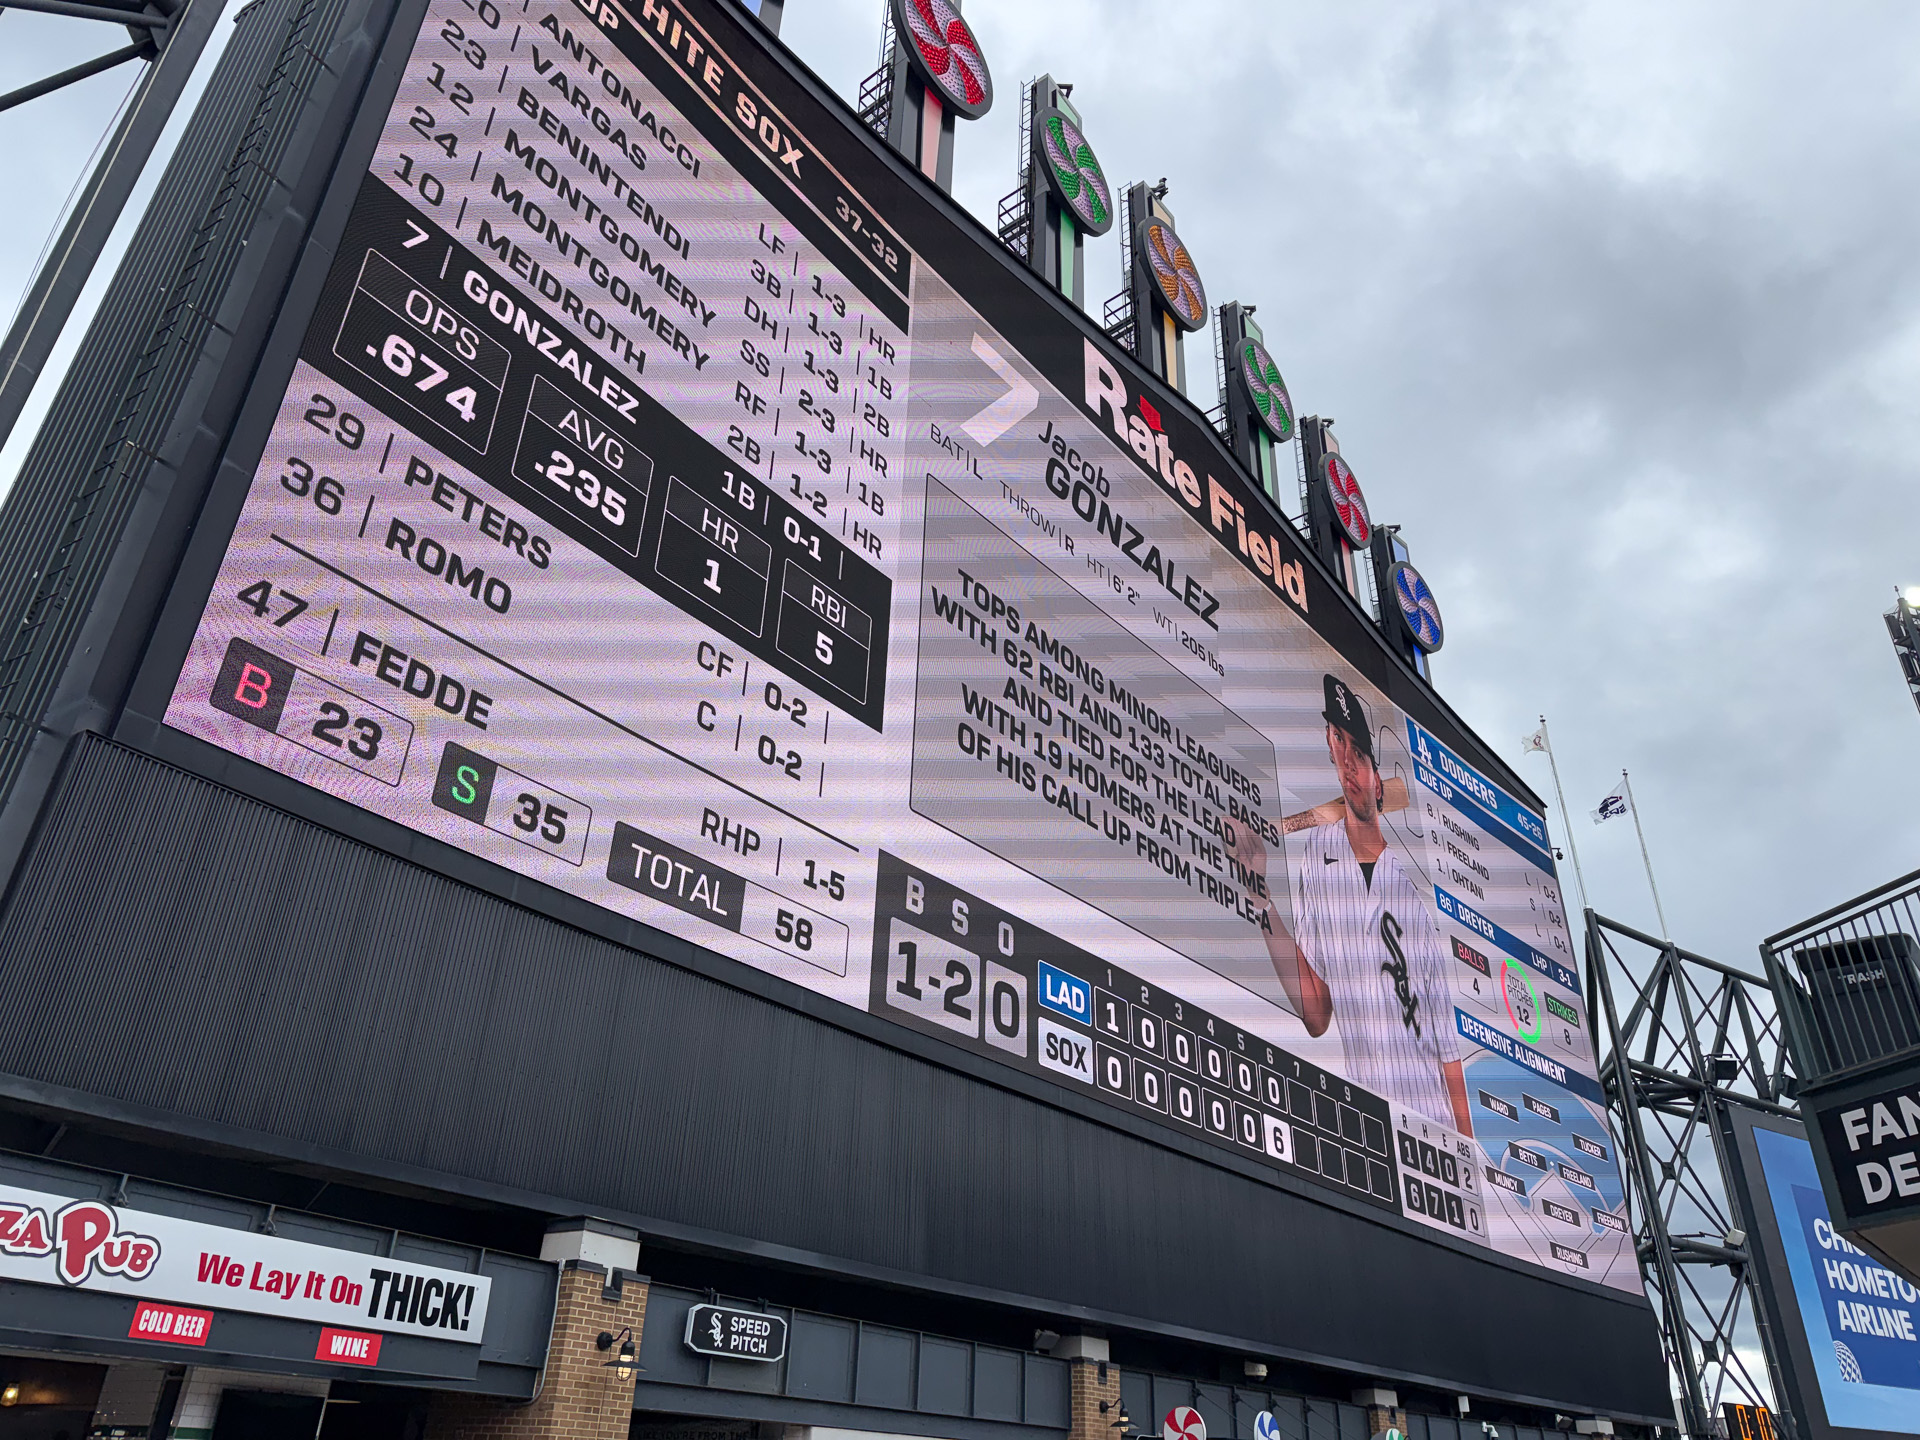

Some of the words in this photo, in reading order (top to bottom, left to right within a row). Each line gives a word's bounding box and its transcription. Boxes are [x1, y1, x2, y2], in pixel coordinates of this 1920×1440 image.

[643, 0, 724, 96] HITE
[735, 91, 804, 179] SOX
[836, 196, 898, 273] 37-32
[441, 19, 486, 70] 23
[517, 87, 691, 260] BENINTENDI
[744, 296, 778, 340] DH
[804, 350, 839, 393] 1-3
[864, 403, 889, 437] 2B
[531, 44, 647, 171] VARGAS
[751, 259, 781, 298] 3B
[808, 312, 842, 355] 1-3
[867, 366, 892, 400] 1B
[539, 13, 700, 180] ANTONACCI
[758, 223, 785, 254] LF
[812, 275, 846, 318] 1-3
[869, 327, 895, 366] HR
[427, 62, 474, 116] 12
[504, 129, 717, 329] MONTGOMERY
[740, 339, 770, 378] SS
[798, 389, 835, 433] 2-3
[860, 440, 887, 478] HR
[409, 105, 458, 161] 24
[491, 172, 711, 372] MONTGOMERY
[735, 380, 766, 416] RF
[795, 431, 832, 474] 1-3
[858, 482, 884, 516] 1B
[393, 153, 445, 207] 10
[477, 219, 647, 374] MEIDROTH
[727, 425, 761, 465] 2B
[790, 474, 828, 518] 1-2
[853, 521, 882, 560] HR
[402, 219, 429, 249] 7
[463, 270, 639, 424] GONZALEZ
[721, 470, 755, 511] 1B
[784, 516, 822, 562] 0-1
[405, 288, 481, 362] OPS
[558, 409, 625, 471] AVG
[702, 508, 739, 553] HR
[811, 584, 847, 628] RBI
[1038, 421, 1110, 498] Jacob
[1084, 337, 1201, 508] Rate
[1208, 474, 1309, 614] Field
[366, 334, 477, 423] .674
[534, 451, 627, 527] .235
[703, 559, 721, 594] 1
[815, 631, 834, 665] 5
[304, 393, 366, 451] 29
[404, 455, 553, 570] PETERS
[697, 641, 734, 678] CF
[765, 681, 808, 728] 0-2
[1045, 457, 1220, 632] GONZALEZ
[280, 457, 345, 517] 36
[384, 517, 512, 614] ROMO
[697, 700, 716, 732] C
[758, 735, 802, 781] 0-2
[932, 585, 997, 655] WITH
[1003, 638, 1033, 680] 62
[1040, 662, 1074, 708] RBI
[1079, 693, 1122, 739] AND
[1128, 726, 1165, 769] 133
[1169, 753, 1226, 812] TOTAL
[1229, 795, 1280, 848] BASES
[958, 568, 1020, 634] TOPS
[1025, 621, 1105, 695] AMONG
[1110, 679, 1172, 744] MINOR
[1176, 727, 1262, 807] LEAGUERS
[237, 580, 309, 630] 47
[349, 630, 493, 731] FEDDE
[701, 806, 760, 856] RHP
[803, 860, 845, 901] 1-5
[1003, 676, 1053, 726] AND
[1058, 709, 1105, 761] TIED
[1109, 744, 1148, 792] FOR
[1152, 773, 1189, 818] THE
[1192, 800, 1236, 848] LEAD
[234, 662, 272, 709] B
[311, 700, 383, 761] 23
[451, 765, 479, 805] S
[513, 793, 568, 845] 35
[631, 843, 727, 916] TOTAL
[775, 908, 812, 951] 58
[962, 682, 1026, 749] WITH
[1034, 731, 1062, 770] 19
[1069, 751, 1155, 829] HOMERS
[1160, 813, 1184, 846] AT
[1187, 828, 1224, 872] THE
[1225, 852, 1267, 900] TIME
[1419, 765, 1438, 792] DUE
[1440, 783, 1453, 801] UP
[1439, 751, 1498, 809] DODGERS
[1517, 812, 1543, 841] 45-26
[958, 722, 991, 761] OF
[997, 744, 1036, 792] HIS
[1042, 774, 1098, 830] CALL
[1103, 809, 1131, 846] UP
[1136, 830, 1191, 887] FROM
[1194, 866, 1273, 935] TRIPLE-A
[1442, 814, 1480, 851] RUSHING
[1447, 841, 1490, 881] FREELAND
[905, 875, 925, 915] B
[951, 898, 969, 936] S
[1452, 868, 1484, 901] OHTANI
[1439, 893, 1453, 913] 86
[1458, 902, 1495, 941] DREYER
[1531, 951, 1548, 972] LHP
[1557, 968, 1573, 987] 3-1
[896, 941, 972, 1021] 1-2
[993, 980, 1020, 1039] 0
[1046, 974, 1085, 1014] LAD
[1457, 943, 1485, 972] BALLS
[1547, 997, 1578, 1026] STRIKES
[1507, 973, 1529, 995] TOTAL
[1516, 1005, 1531, 1027] 12
[1461, 1013, 1514, 1058] DEFENSIVE
[1515, 1048, 1567, 1085] ALIGNMENT
[1046, 1032, 1088, 1073] SOX
[1273, 1126, 1285, 1155] 6
[1489, 1097, 1509, 1116] WARD
[1532, 1100, 1552, 1119] PAGES
[1494, 1171, 1518, 1192] MUNCY
[1518, 1148, 1538, 1166] BETTS
[1563, 1167, 1592, 1188] FREELAND
[1579, 1138, 1602, 1158] TUCKER
[1856, 1151, 1920, 1205] DE
[1550, 1204, 1574, 1224] DREYER
[1596, 1212, 1623, 1231] FREEMAN
[197, 1252, 245, 1287] We
[249, 1261, 302, 1300] Lay
[304, 1270, 327, 1300] It
[329, 1275, 364, 1307] On
[368, 1268, 476, 1332] THICK!
[1556, 1246, 1583, 1266] RUSHING
[1822, 1258, 1920, 1304] HOMETO
[138, 1309, 171, 1335] COLD
[172, 1313, 206, 1339] BEER
[330, 1335, 370, 1359] WINE
[730, 1316, 771, 1337] SPEED
[730, 1334, 767, 1354] PITCH
[1837, 1300, 1917, 1342] AIRLINE
